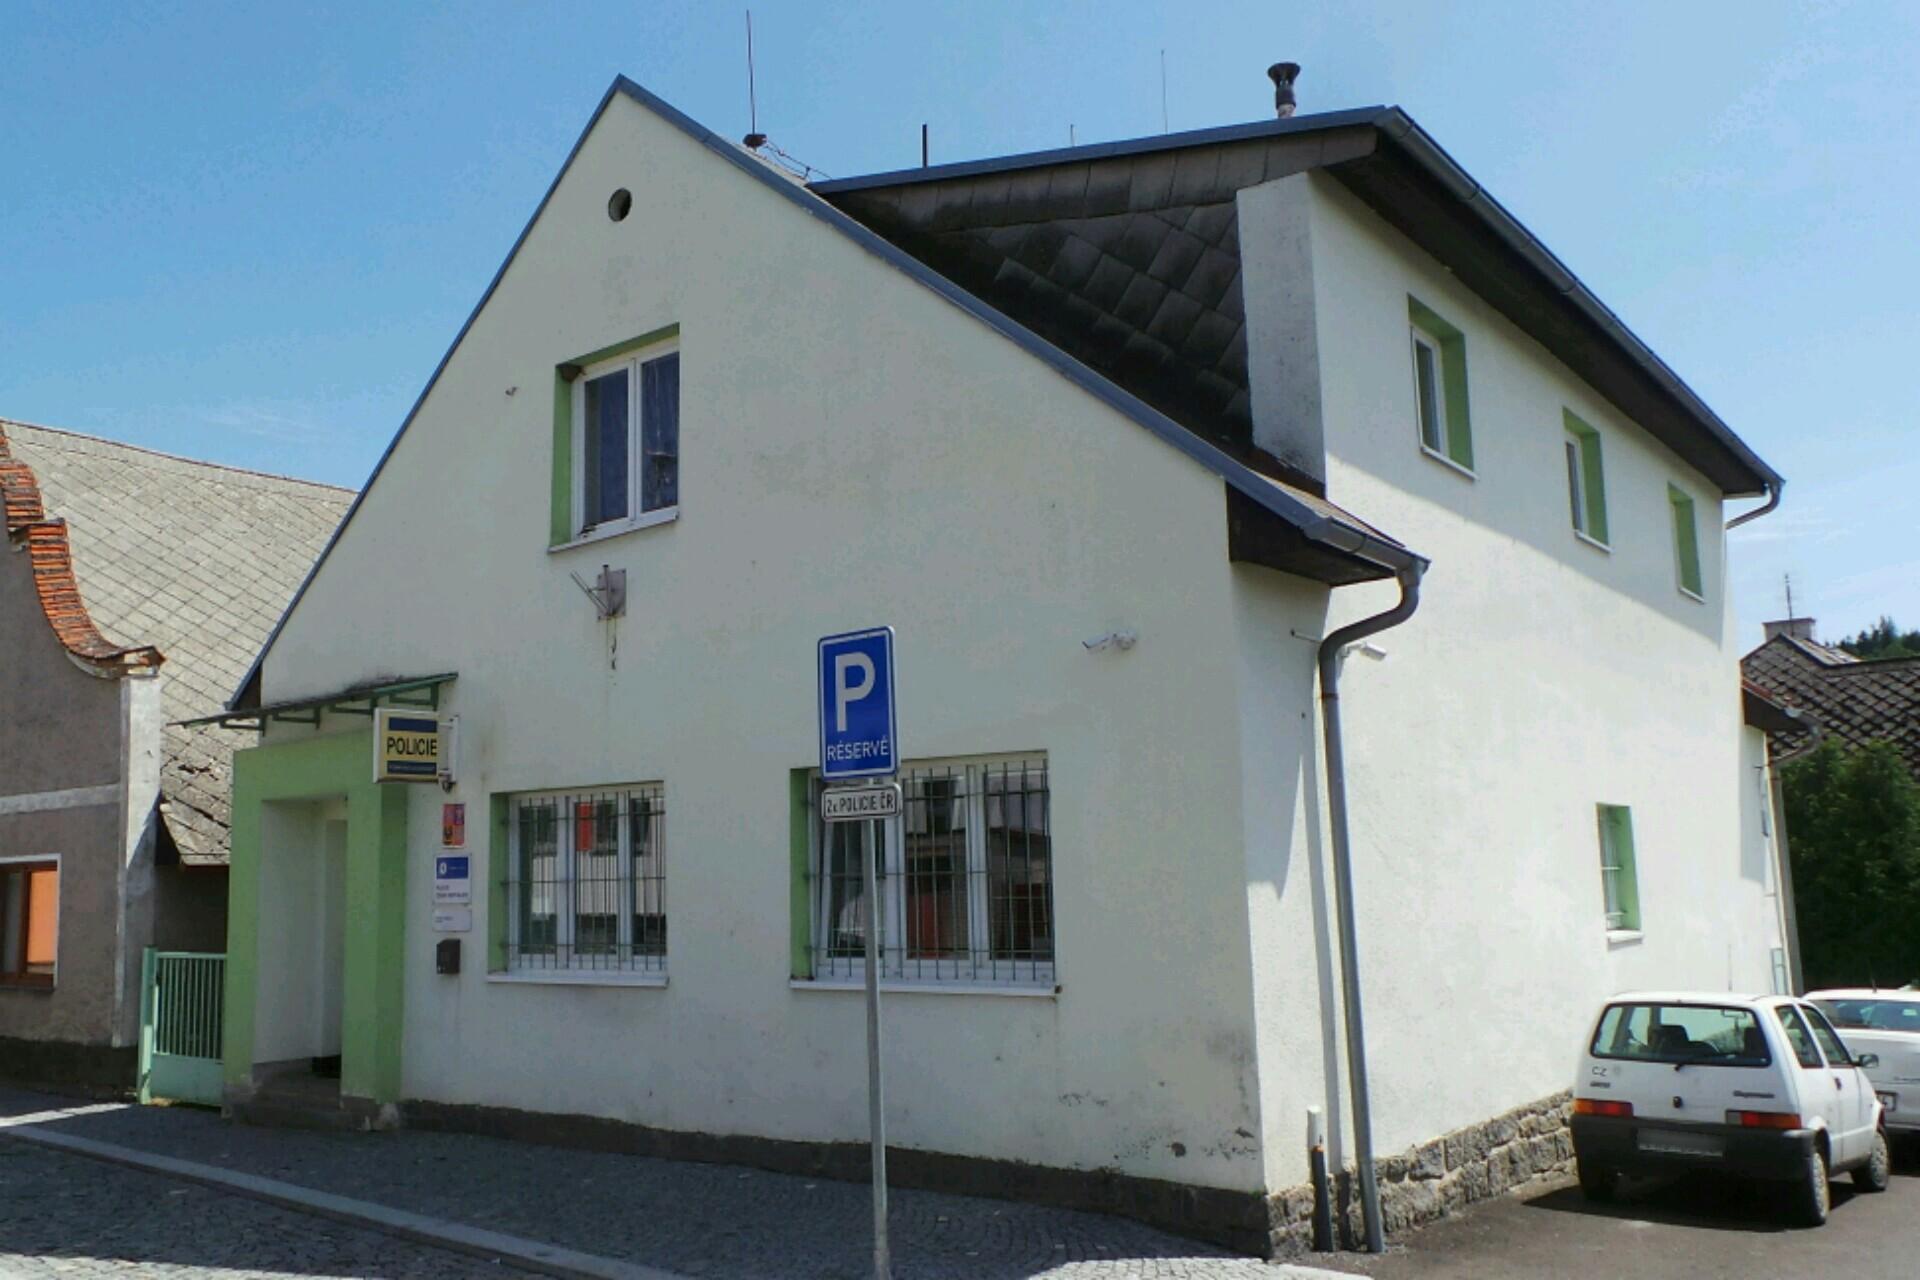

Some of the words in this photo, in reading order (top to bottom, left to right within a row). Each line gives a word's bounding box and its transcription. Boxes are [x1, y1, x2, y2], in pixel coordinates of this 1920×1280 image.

[835, 652, 875, 731] P
[387, 736, 437, 756] POLICIE
[827, 735, 889, 760] RÉSERVÉ
[841, 795, 877, 812] POLICIE
[880, 791, 893, 809] ČR
